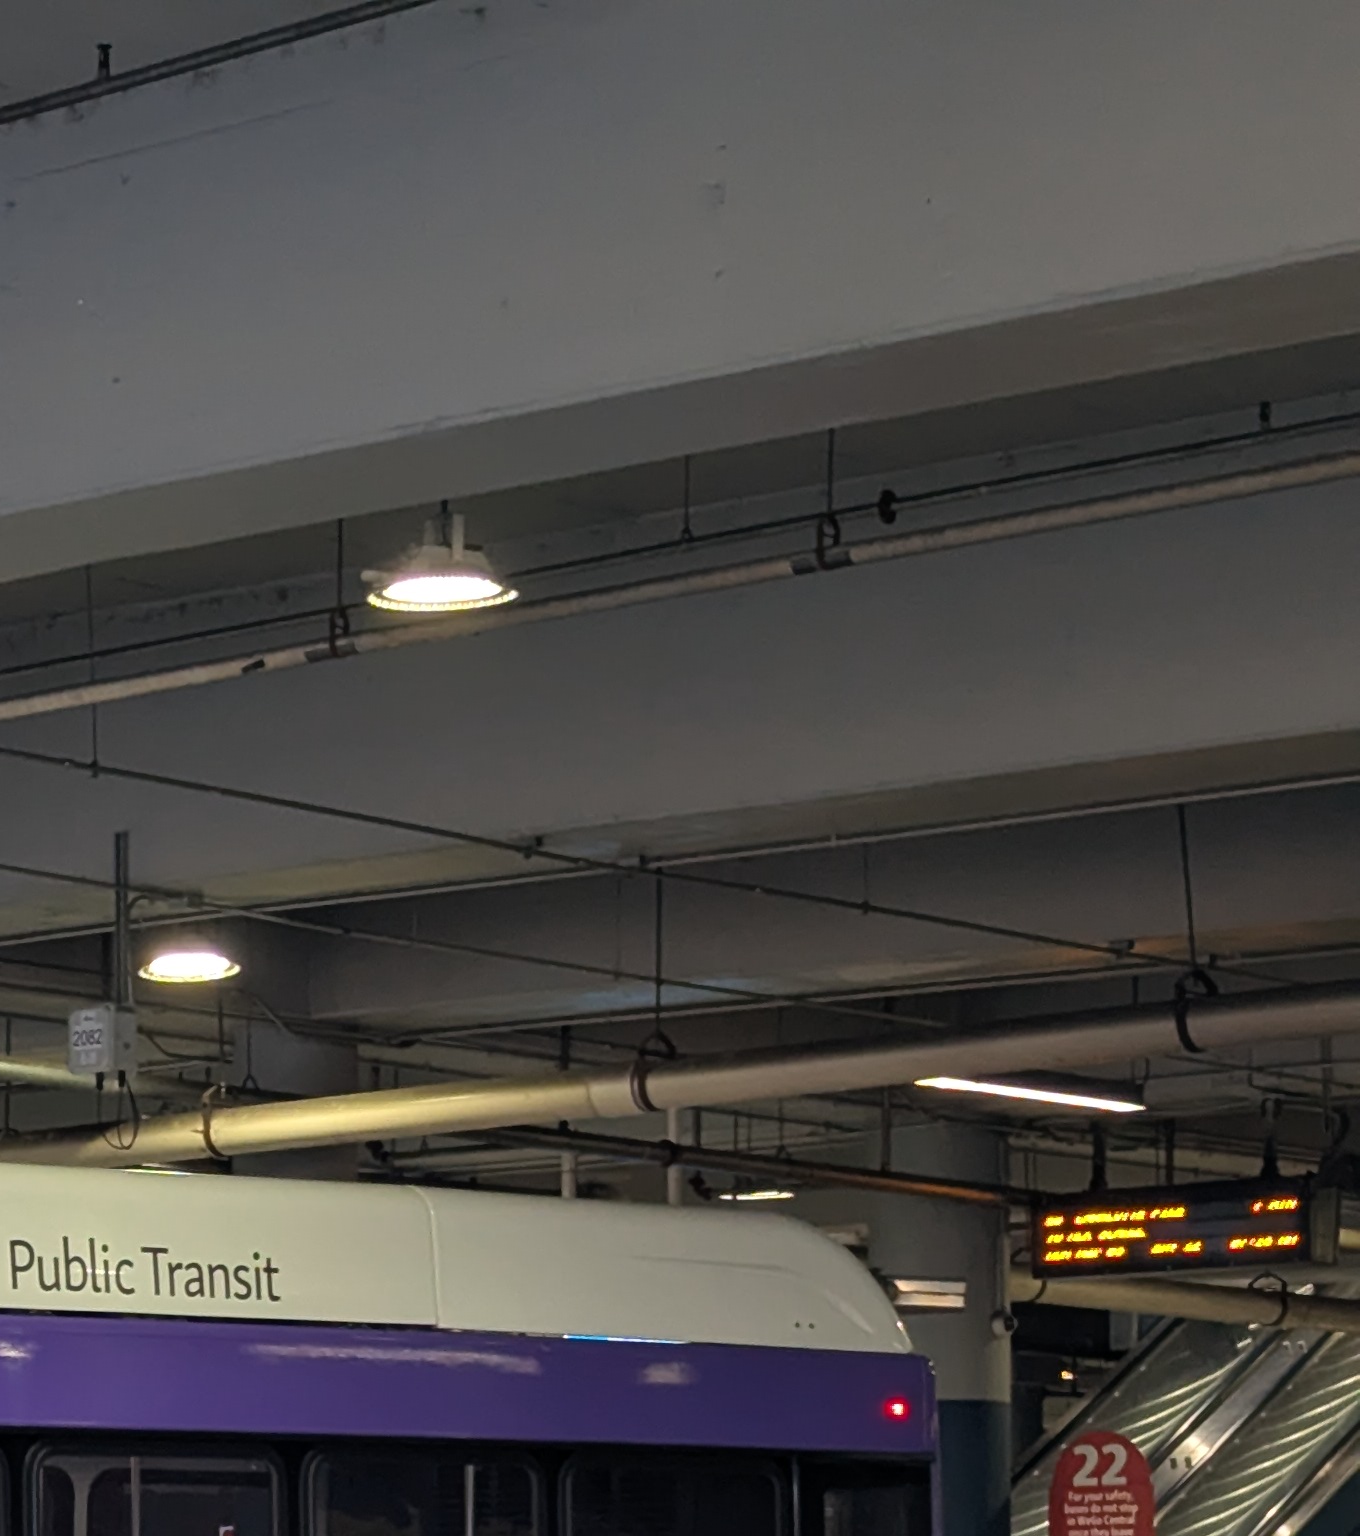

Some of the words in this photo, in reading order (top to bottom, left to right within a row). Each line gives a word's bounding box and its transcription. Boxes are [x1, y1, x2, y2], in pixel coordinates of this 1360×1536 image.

[9, 1236, 135, 1295] Public
[140, 1246, 281, 1302] Transit
[1072, 1443, 1128, 1487] 22
[1068, 1491, 1083, 1501] For
[1084, 1493, 1104, 1504] your
[1090, 1503, 1101, 1513] do
[1102, 1503, 1117, 1513] not
[1118, 1503, 1138, 1516] stop
[1103, 1514, 1135, 1525] Central
[1111, 1527, 1134, 1536] leave
